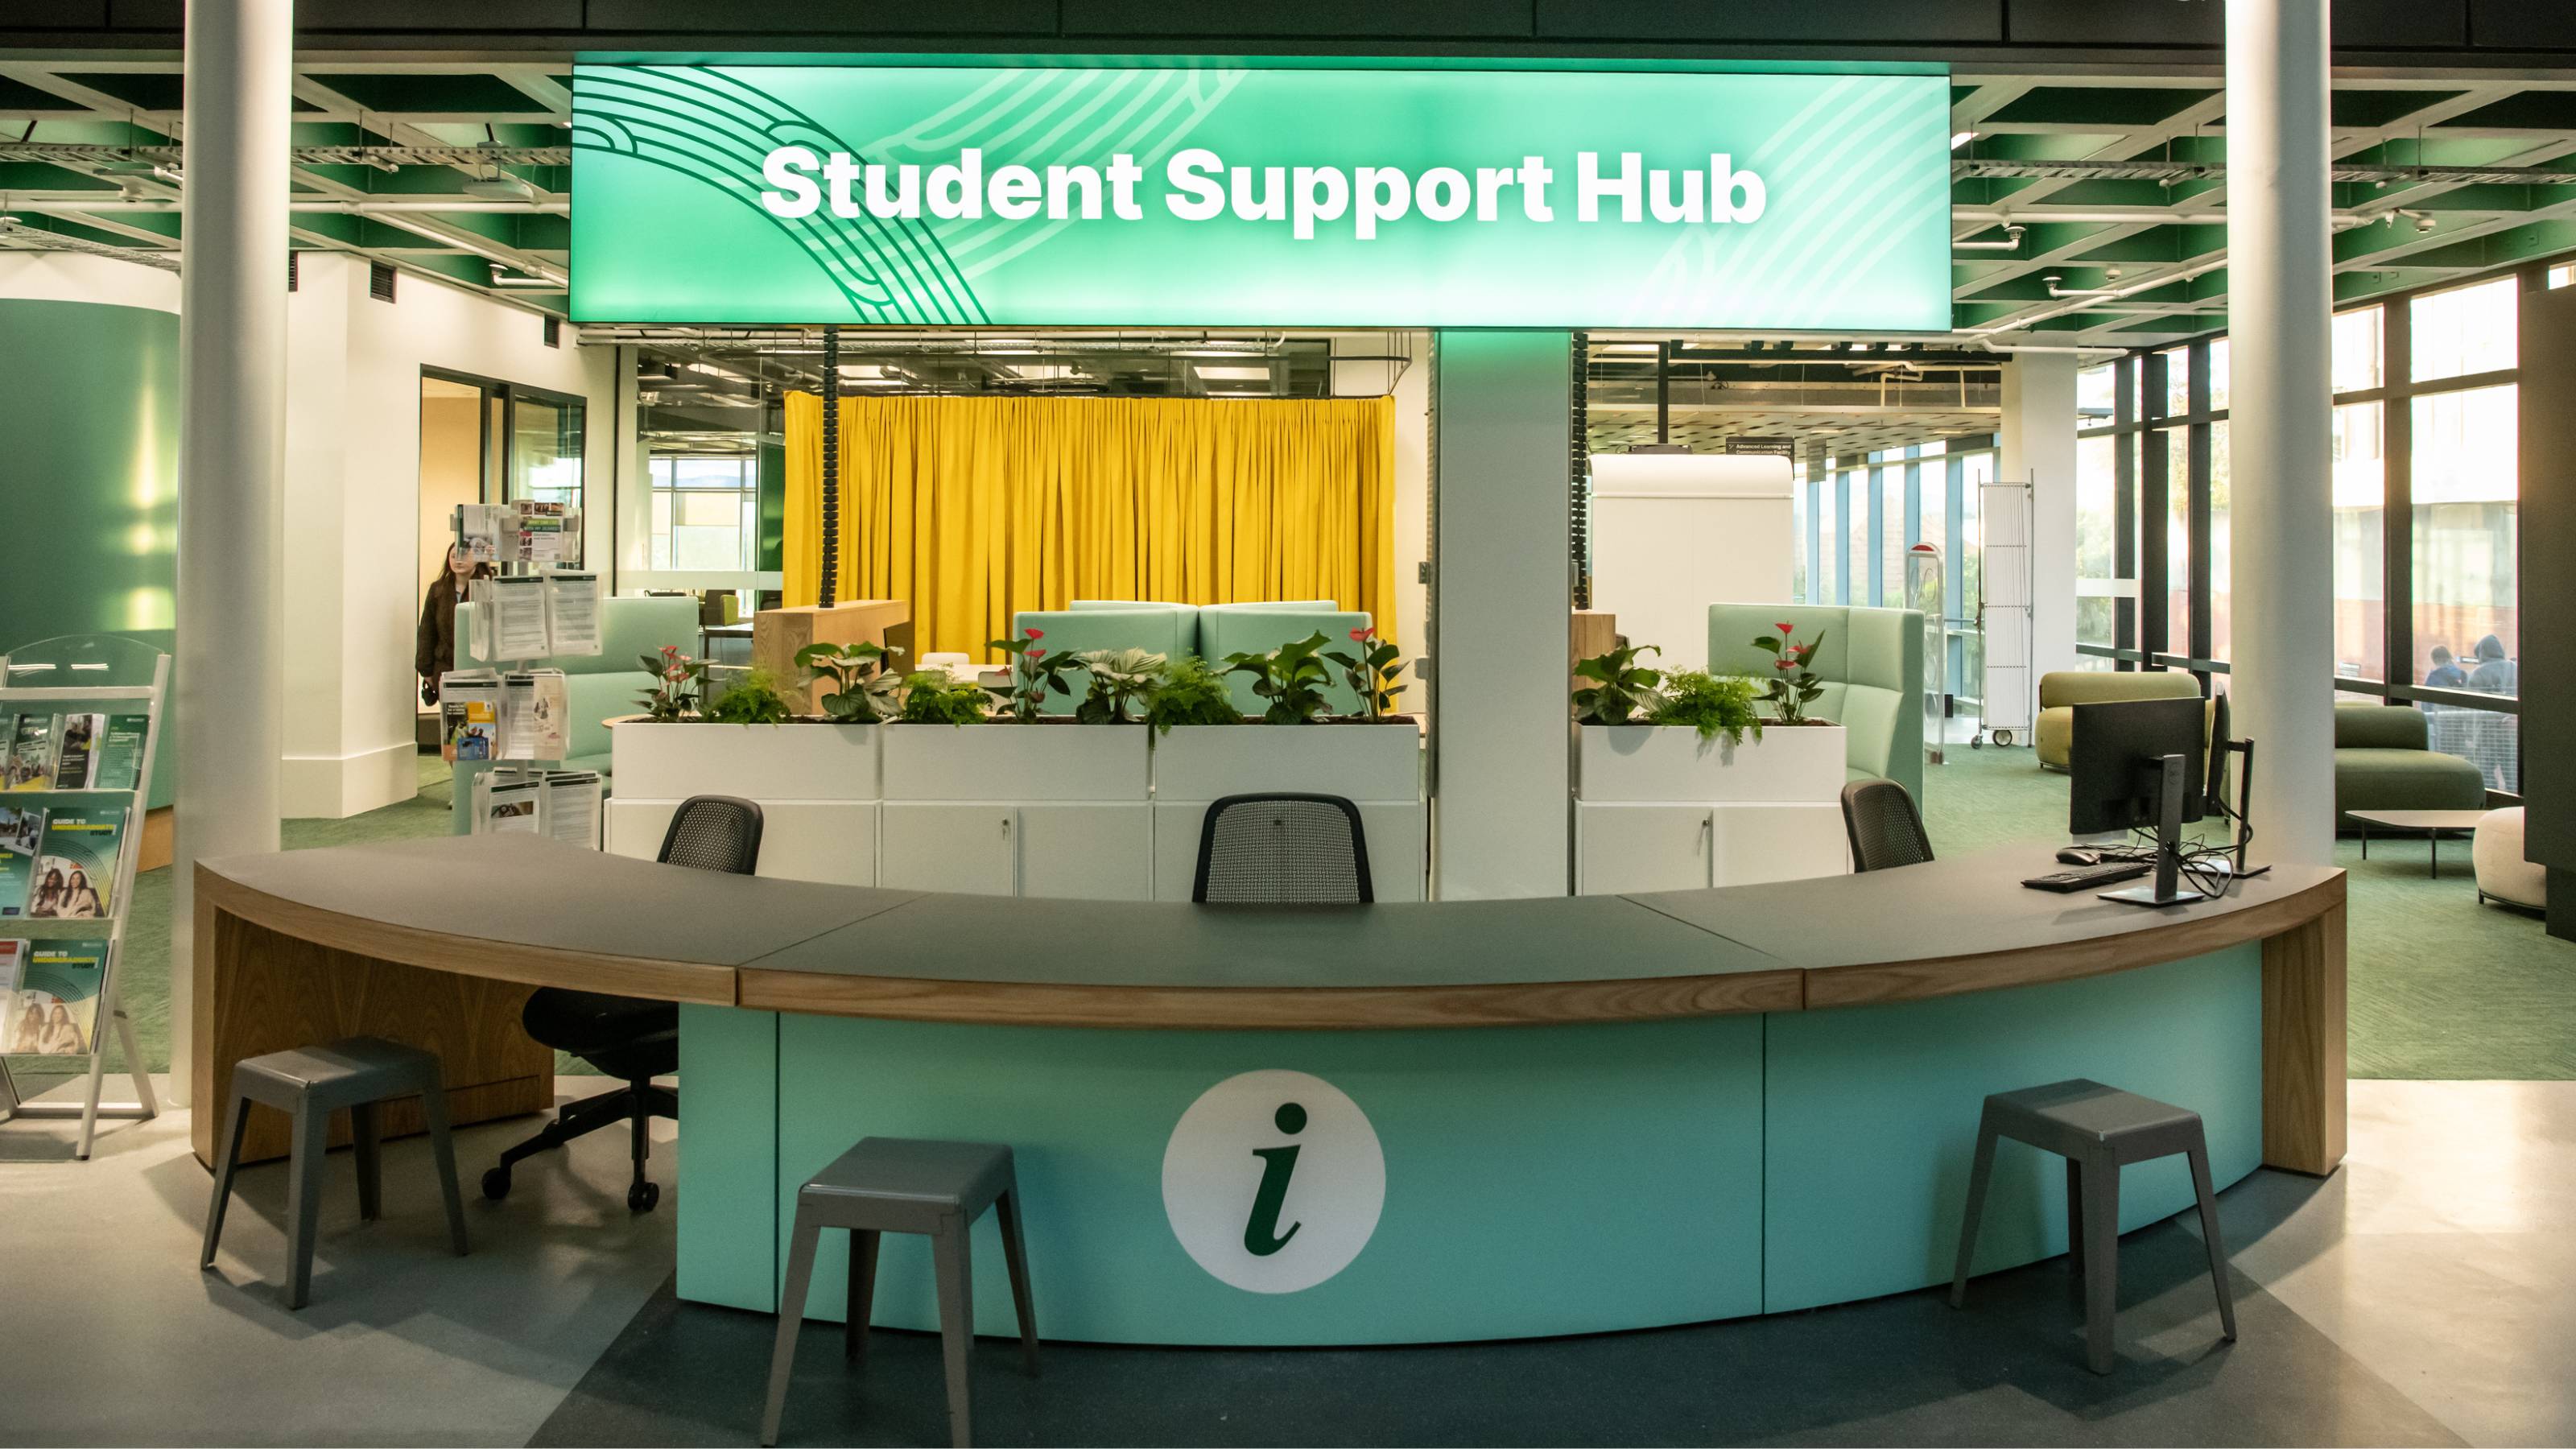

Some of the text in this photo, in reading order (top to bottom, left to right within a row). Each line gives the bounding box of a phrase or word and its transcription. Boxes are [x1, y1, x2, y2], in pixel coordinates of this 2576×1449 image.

[761, 146, 1767, 241] Student Support Hub
